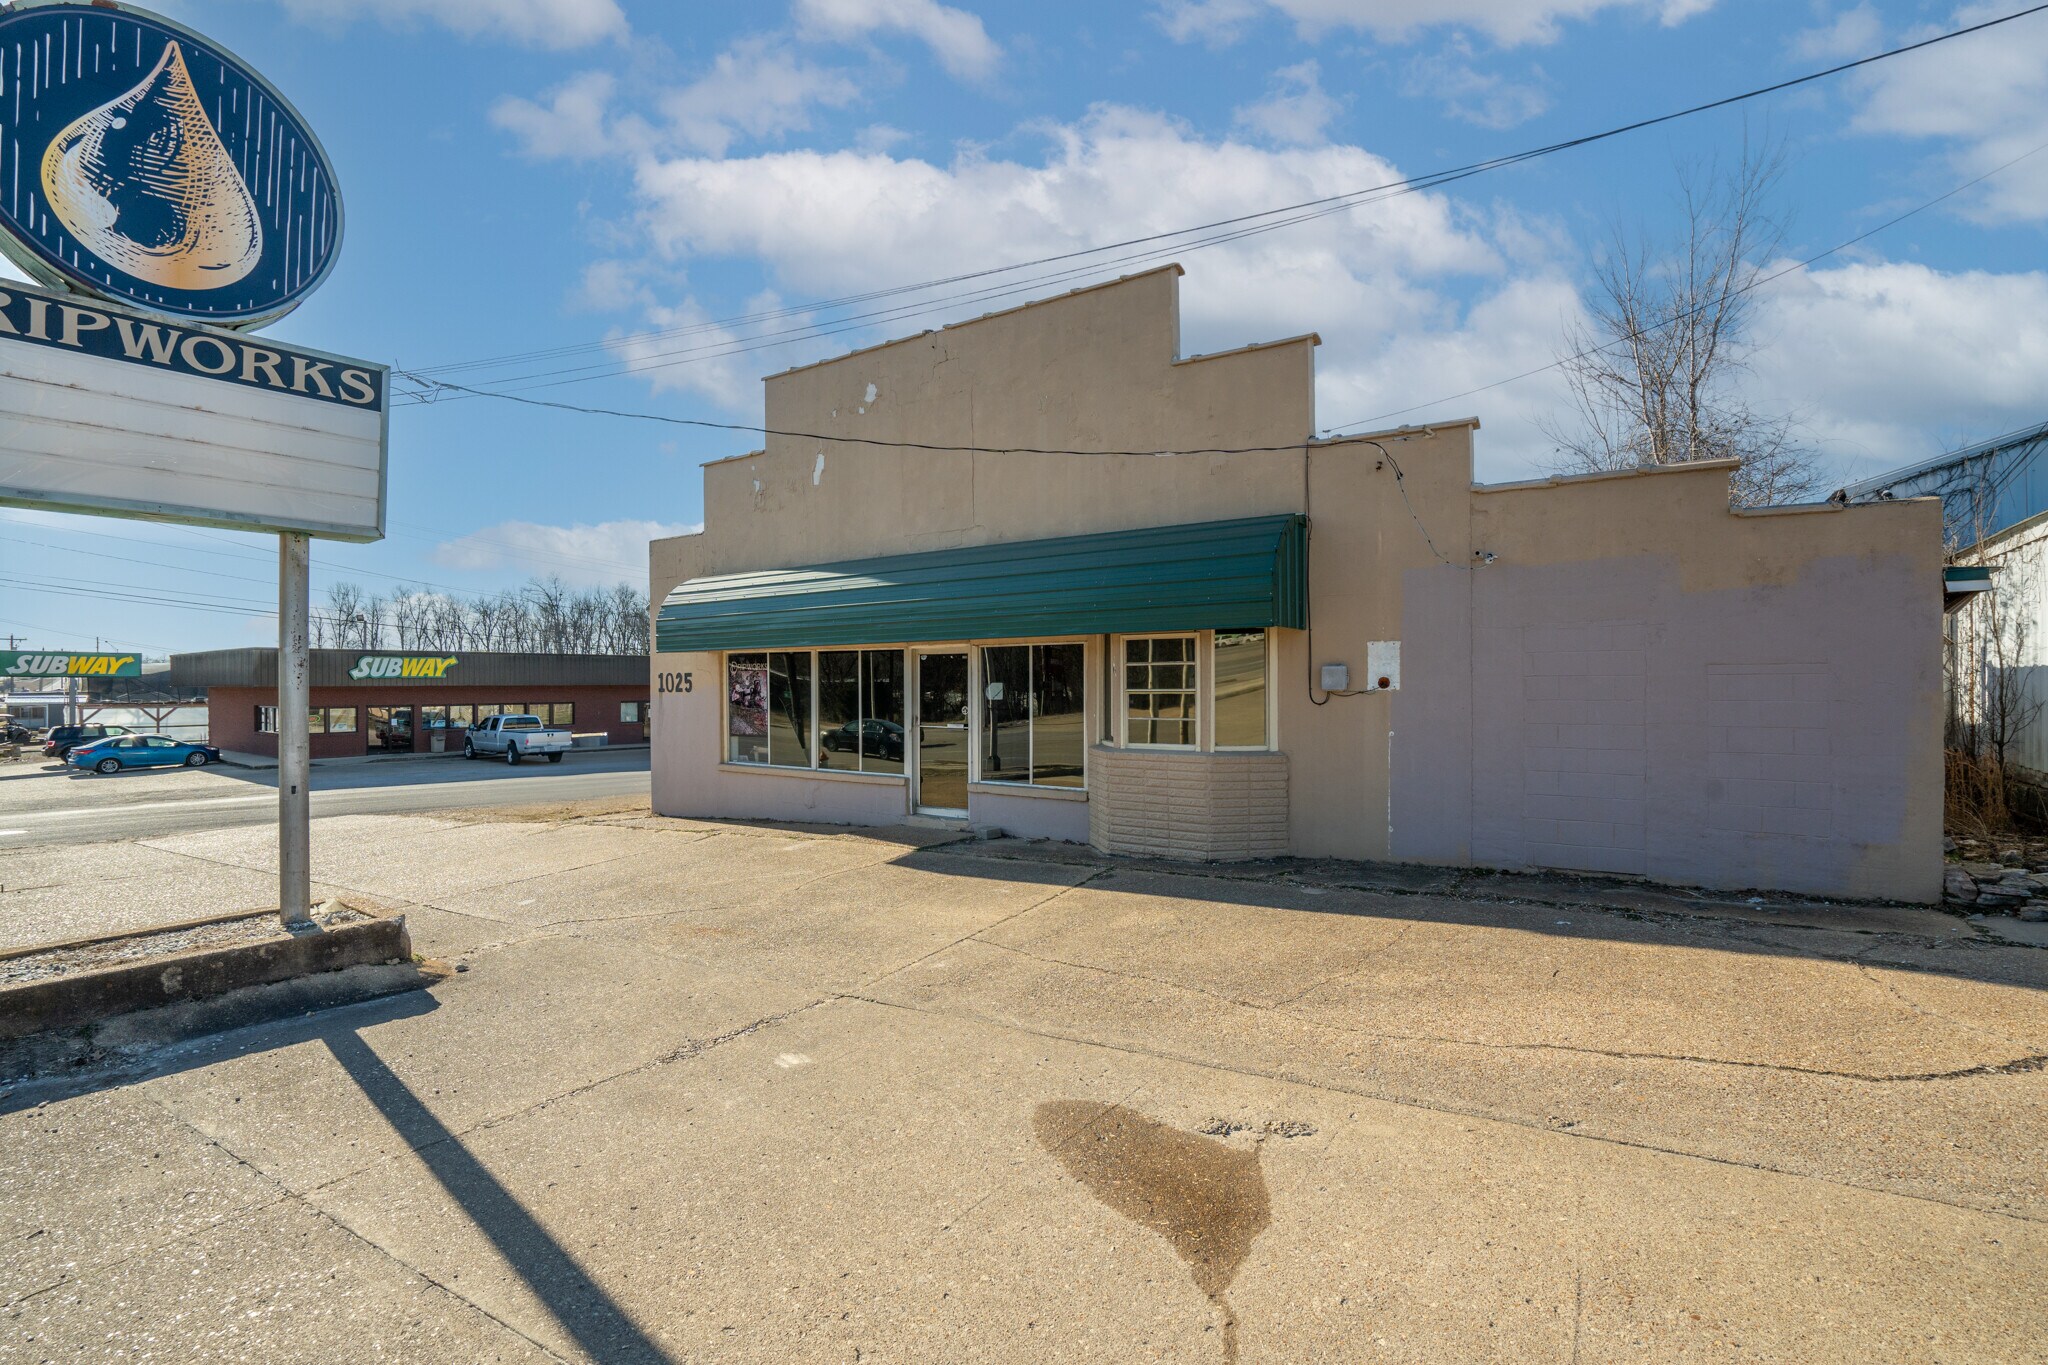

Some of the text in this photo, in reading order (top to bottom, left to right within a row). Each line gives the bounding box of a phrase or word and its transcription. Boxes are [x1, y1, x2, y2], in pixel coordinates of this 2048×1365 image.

[5, 654, 135, 675] SUBWAY
[350, 656, 458, 678] SUBWAY
[658, 672, 692, 692] 1025
